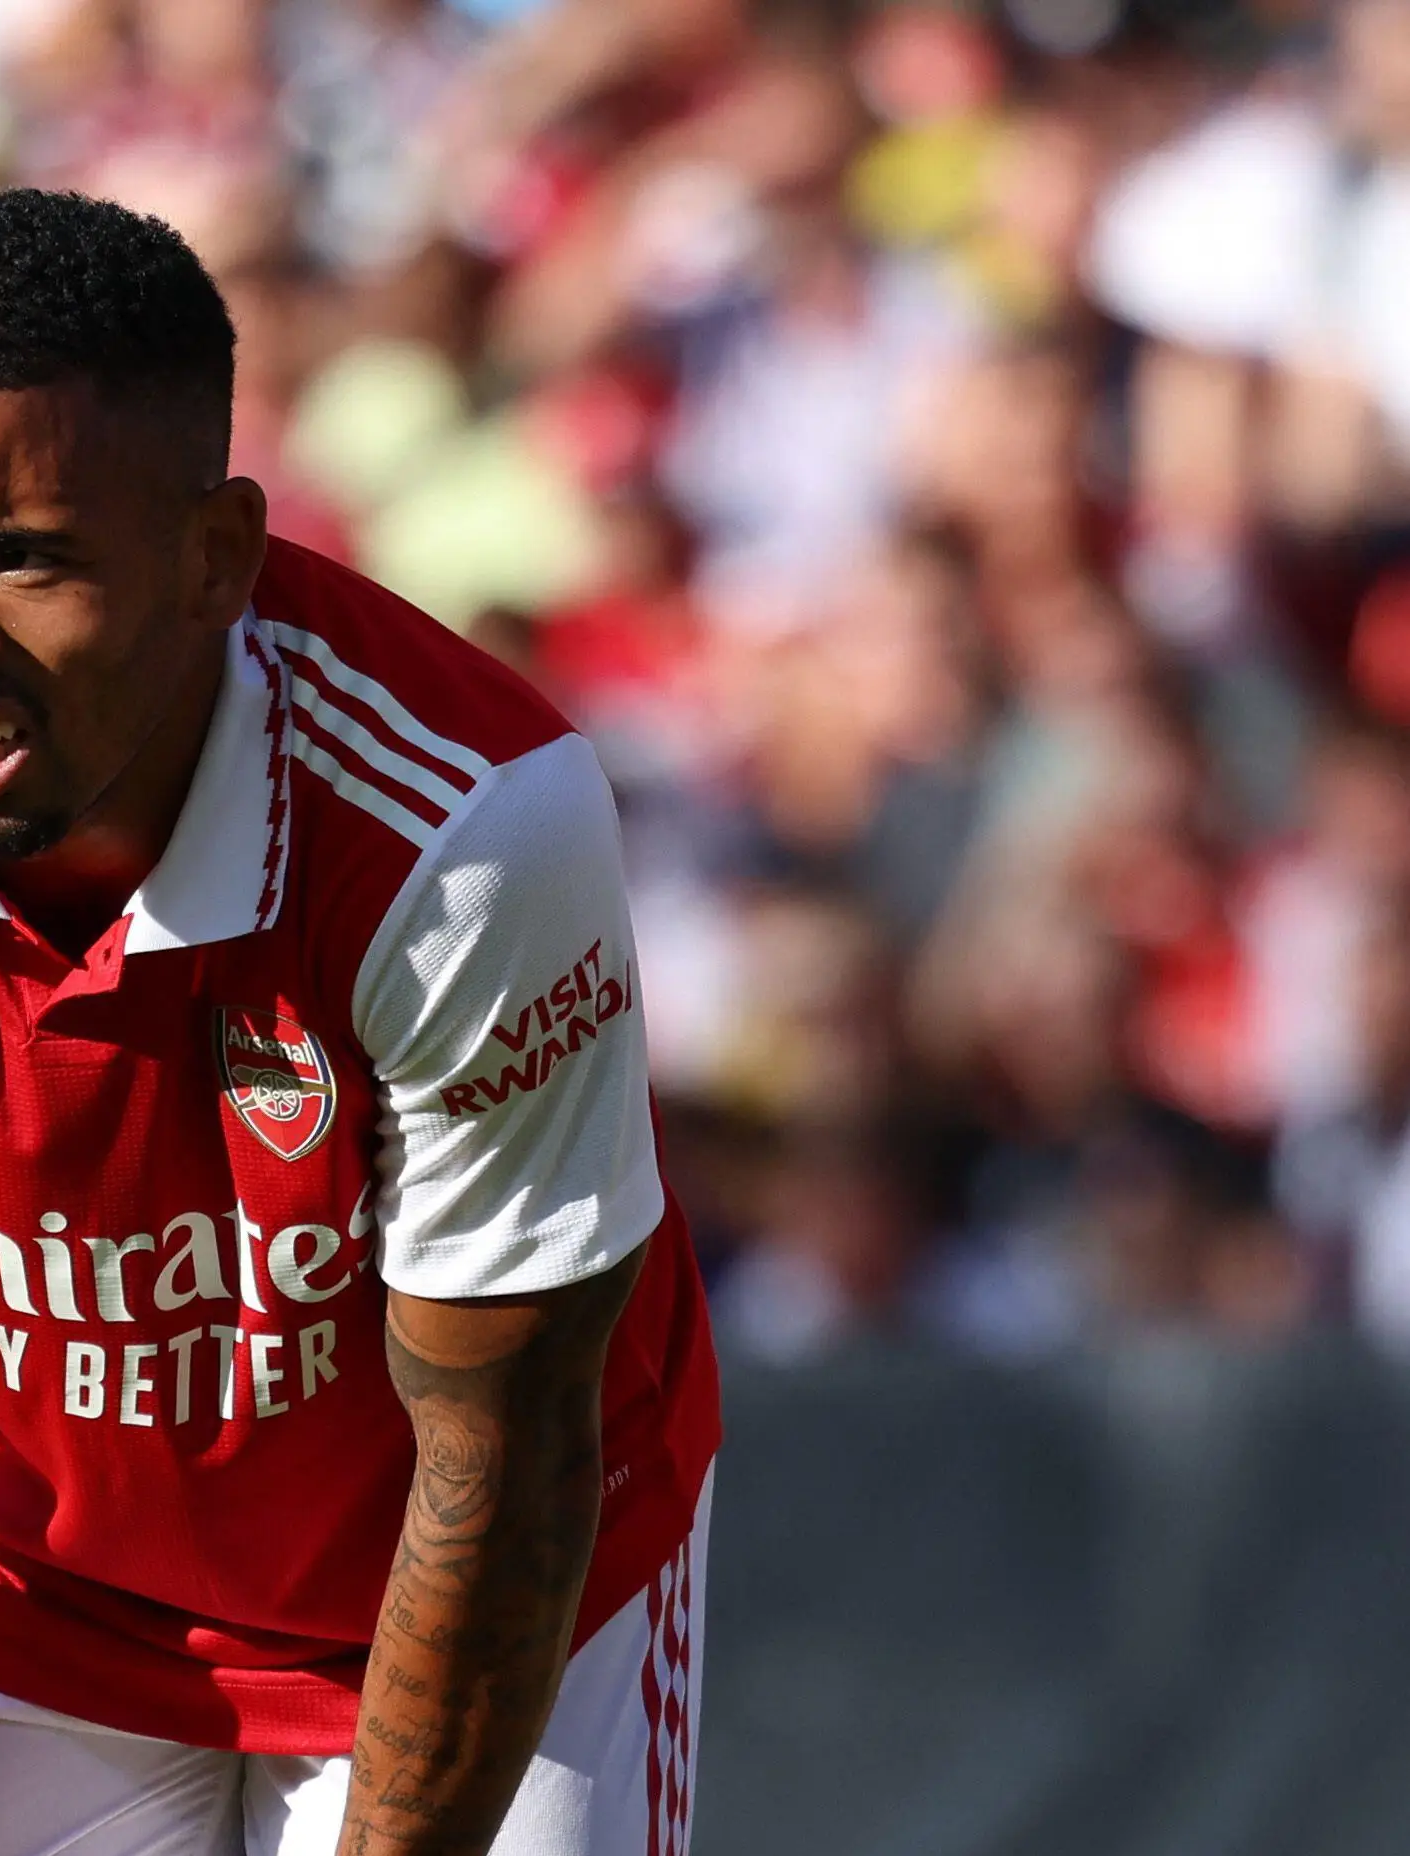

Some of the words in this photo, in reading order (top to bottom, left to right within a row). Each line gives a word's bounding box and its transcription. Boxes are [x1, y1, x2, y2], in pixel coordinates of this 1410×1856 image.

[228, 1025, 314, 1066] Arsenal
[491, 937, 601, 1052] VISIT
[64, 1319, 339, 1427] BETTER
